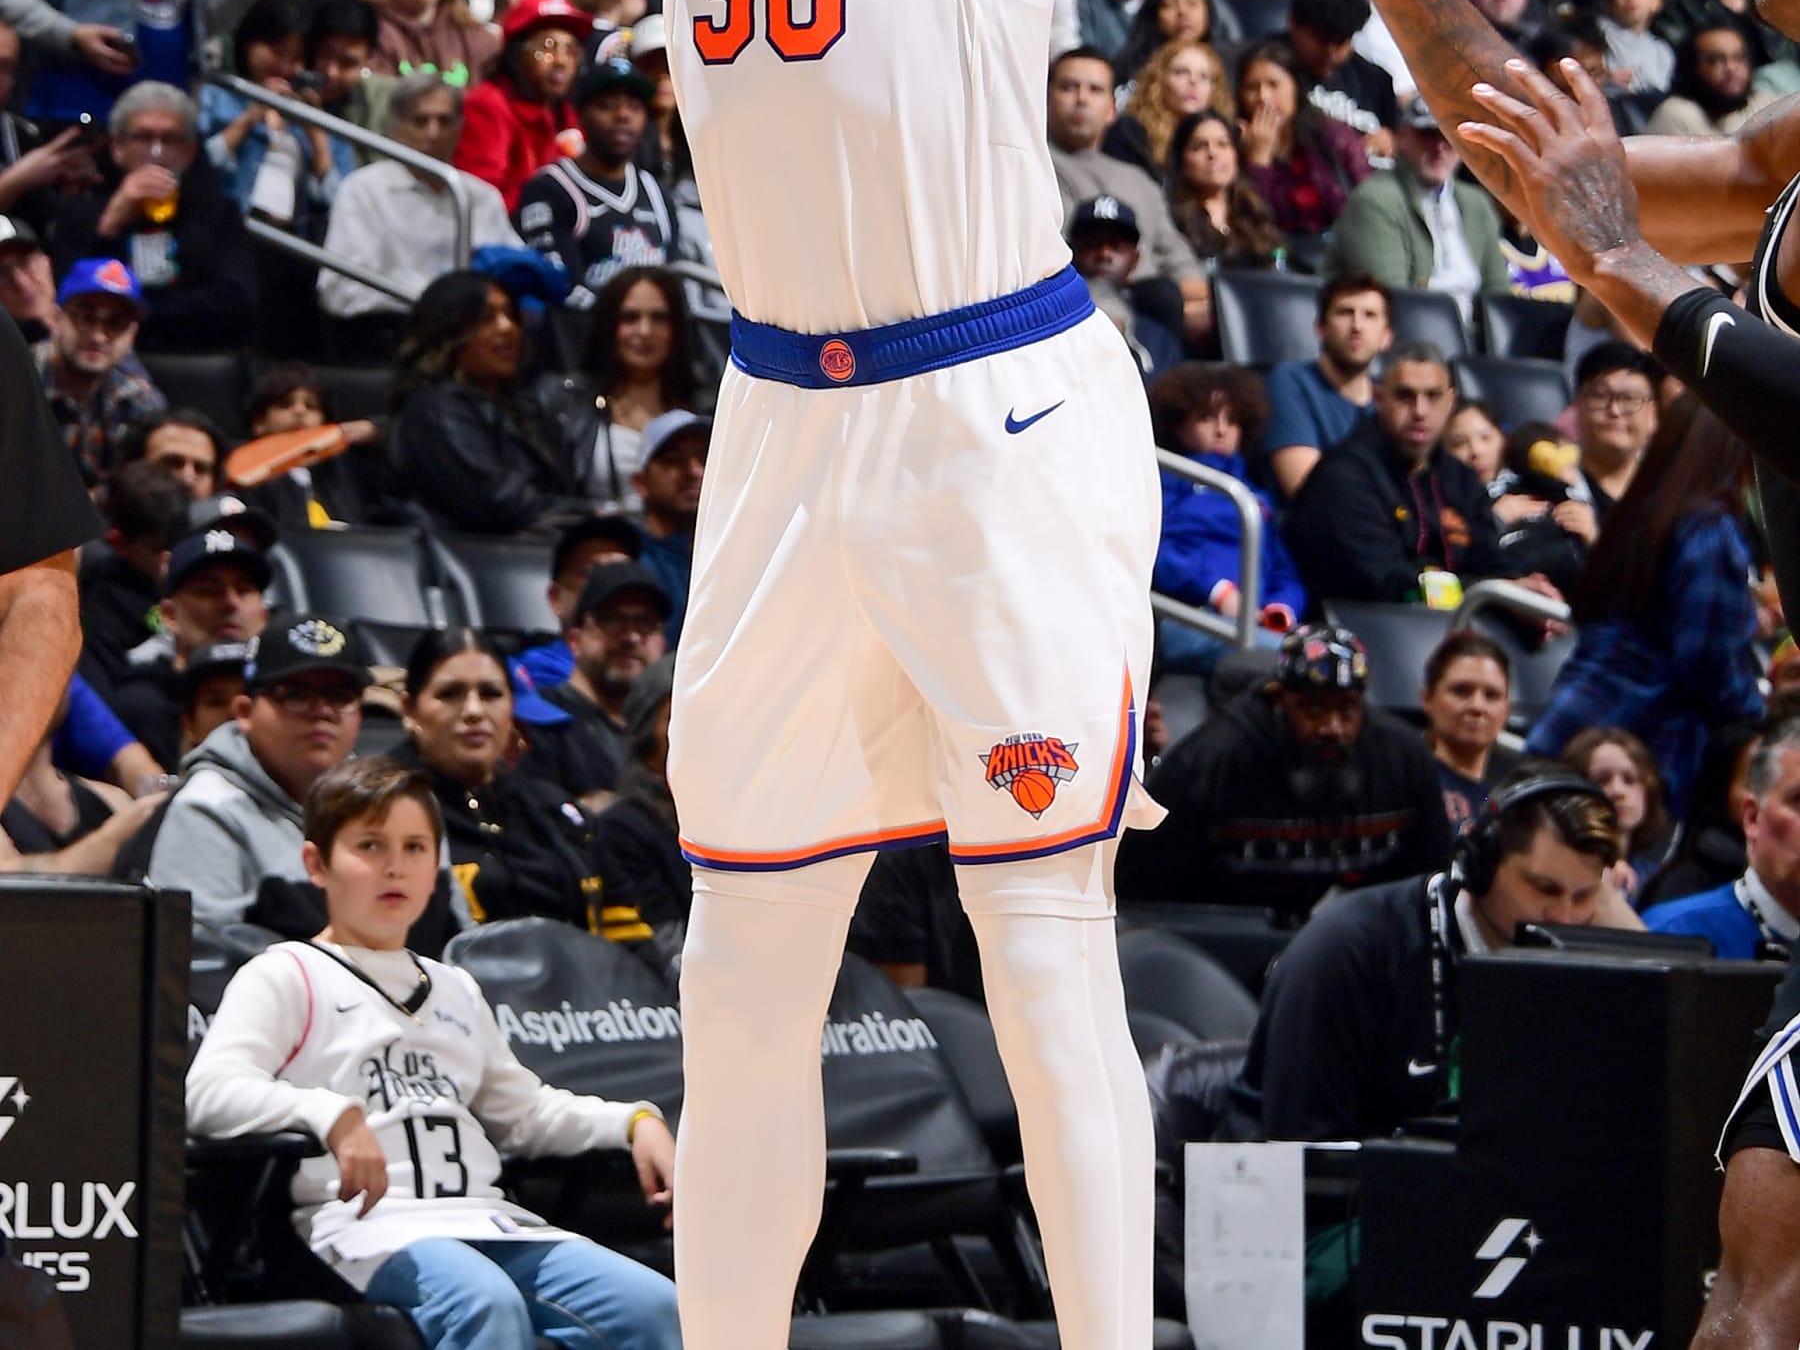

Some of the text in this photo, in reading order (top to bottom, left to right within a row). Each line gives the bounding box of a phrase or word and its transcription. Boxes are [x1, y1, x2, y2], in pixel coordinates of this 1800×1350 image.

[986, 737, 1079, 782] KNICKS
[1005, 732, 1044, 744] NEW YORK
[496, 998, 681, 1054] Aspiration
[402, 1115, 468, 1198] 13
